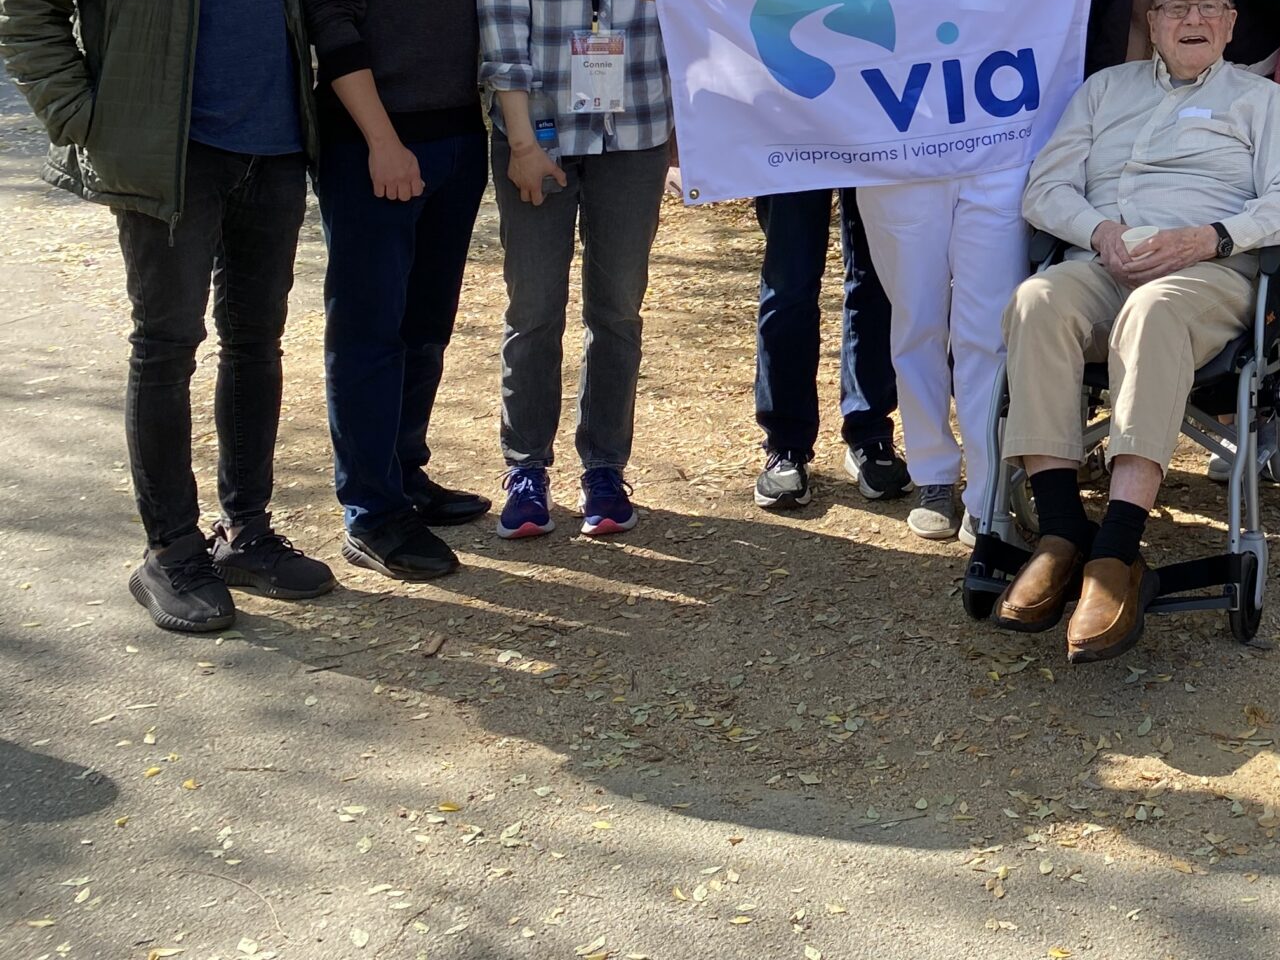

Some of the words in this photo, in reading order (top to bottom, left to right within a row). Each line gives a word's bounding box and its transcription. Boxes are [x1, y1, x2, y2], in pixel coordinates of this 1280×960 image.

[583, 61, 613, 69] Connie
[860, 21, 1041, 133] via
[768, 148, 899, 168] @viaprograms
[912, 123, 1033, 159] viaprograms.og
